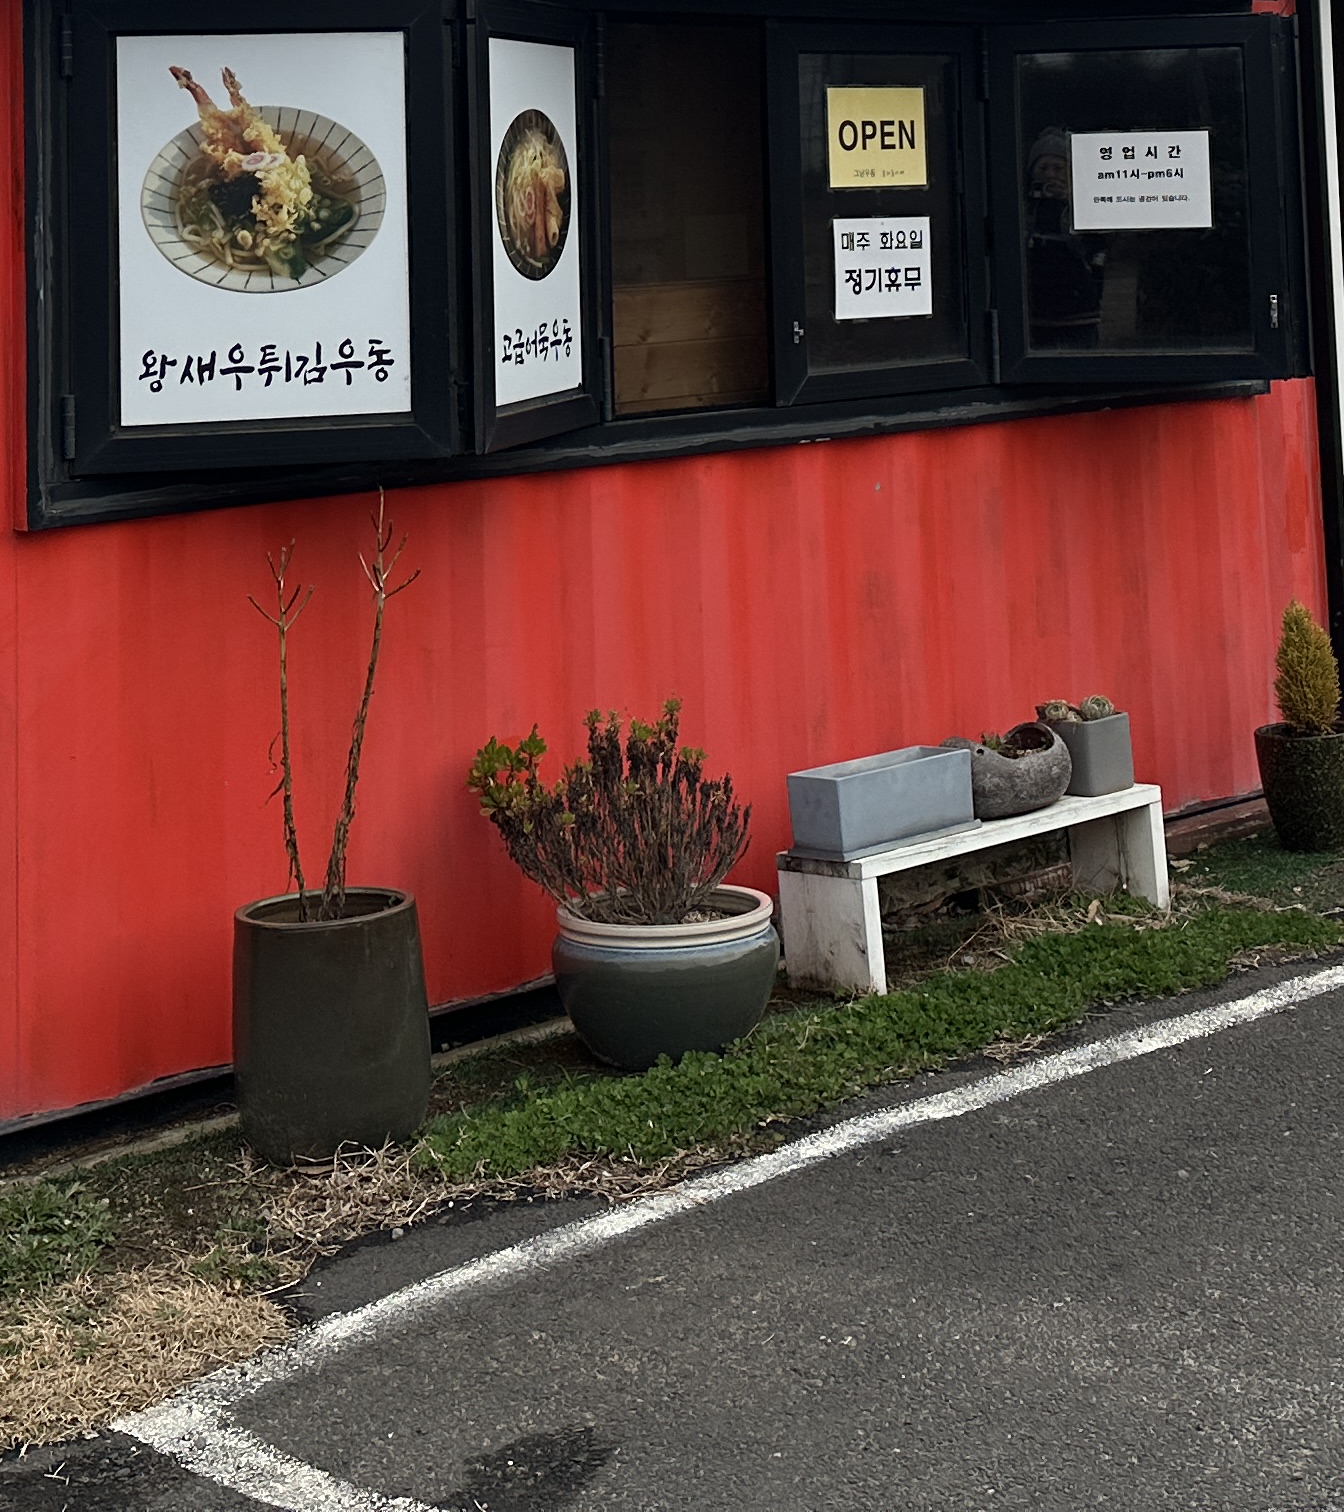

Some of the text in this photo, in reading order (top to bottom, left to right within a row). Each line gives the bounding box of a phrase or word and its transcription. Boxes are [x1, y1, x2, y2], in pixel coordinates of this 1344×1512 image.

[838, 119, 916, 152] OPEN
[841, 230, 923, 251] 매주 화요일
[845, 267, 922, 295] 정기휴무
[501, 318, 573, 366] 고급어묵우동
[138, 338, 395, 393] 왕새우튀김우동
